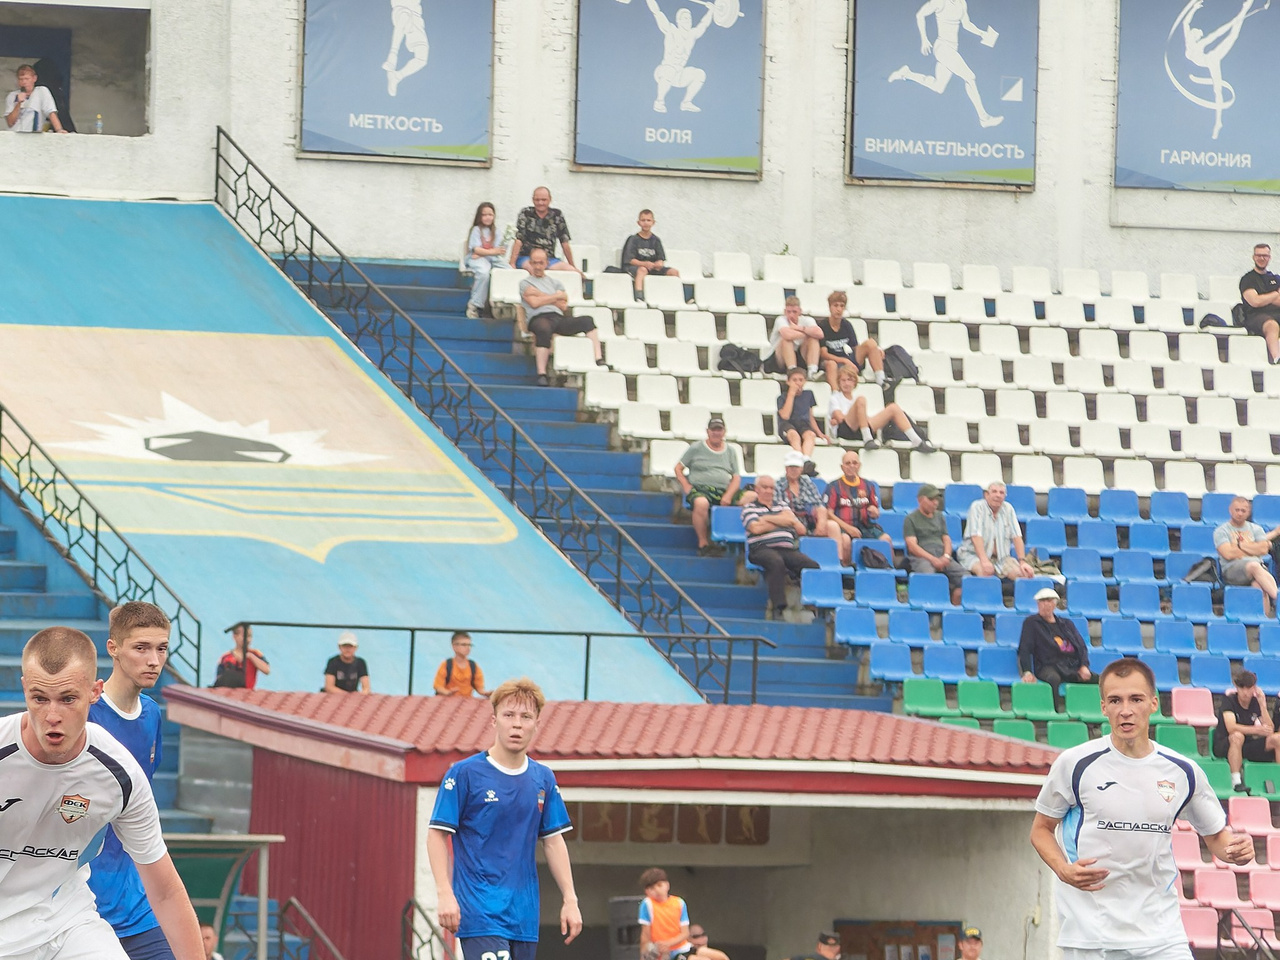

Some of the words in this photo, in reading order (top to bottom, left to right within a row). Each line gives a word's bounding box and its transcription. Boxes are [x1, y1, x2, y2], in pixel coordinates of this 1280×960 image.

[348, 113, 443, 133] МЕТКОСТЬ
[645, 127, 692, 144] ВОЛЯ
[864, 138, 1025, 159] ВНИМАТЕЛЬНОСТЬ
[1160, 149, 1252, 168] ГАРМОНИЯ
